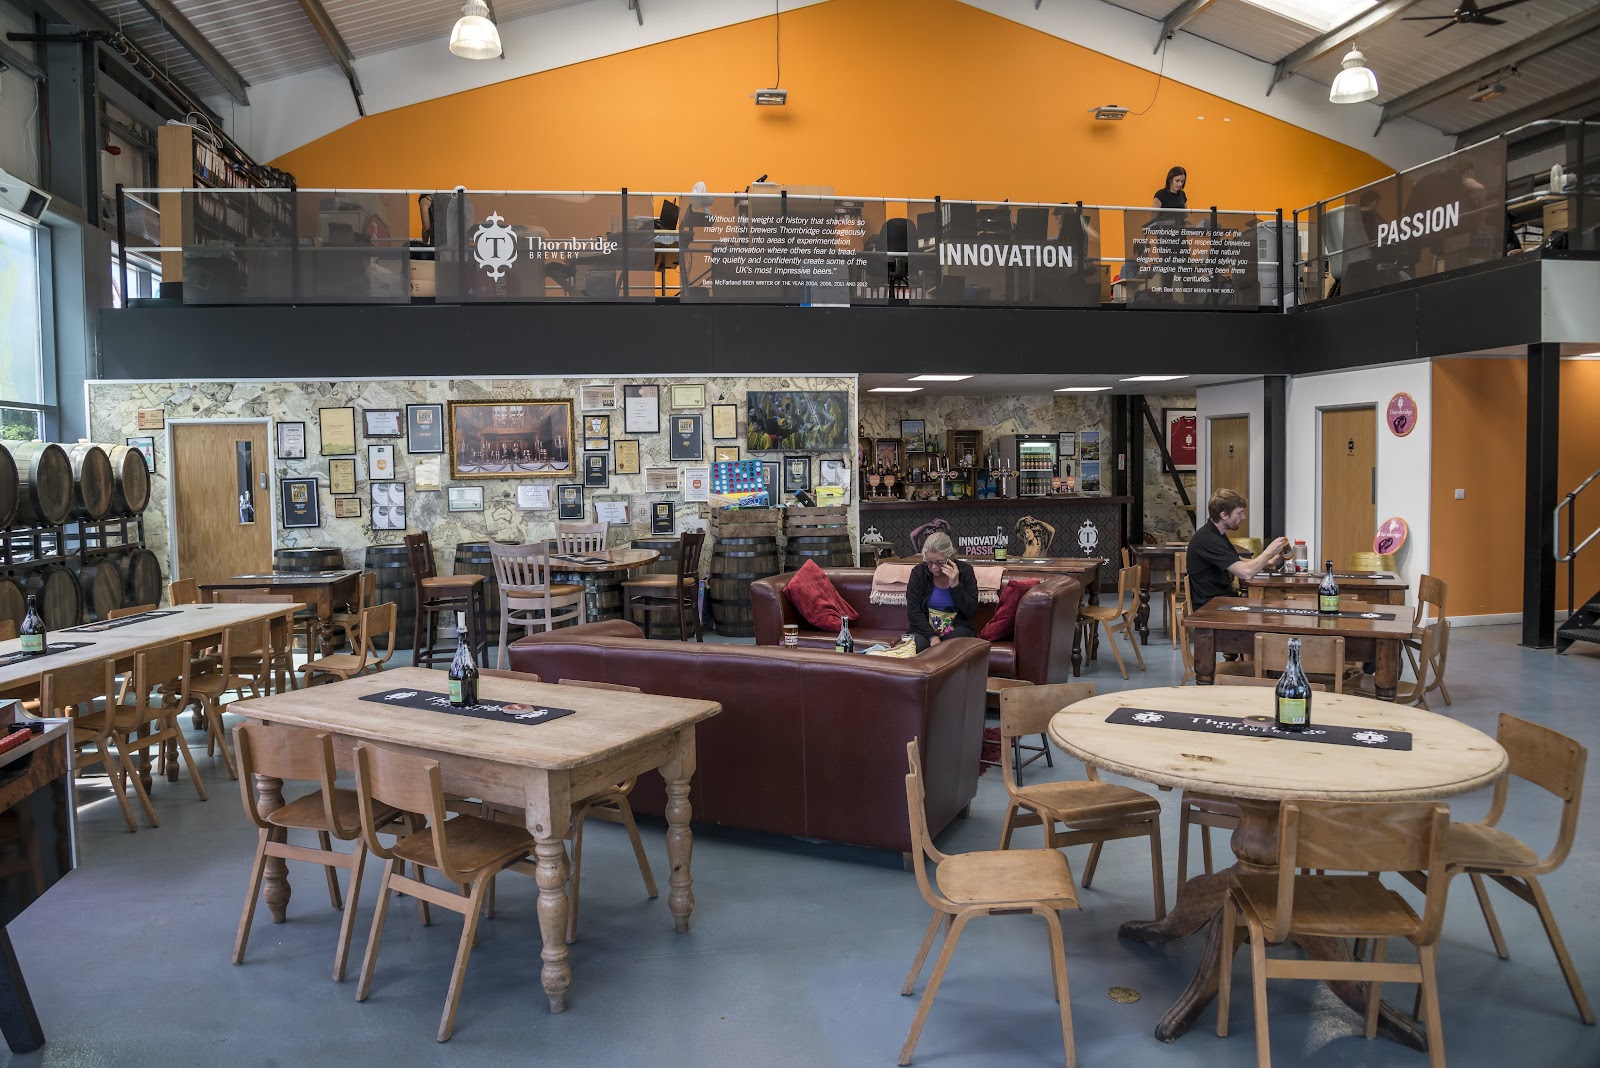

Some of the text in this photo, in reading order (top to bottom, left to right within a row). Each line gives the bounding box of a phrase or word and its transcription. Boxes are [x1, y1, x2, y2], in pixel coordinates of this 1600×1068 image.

[737, 215, 749, 223] the
[751, 216, 774, 225] weight
[776, 216, 784, 224] of
[785, 217, 809, 226] history
[810, 217, 825, 225] that
[826, 218, 855, 226] shackles
[1377, 201, 1460, 248] PASSION
[703, 225, 867, 237] many British brewers Thornbridge courageously
[1181, 229, 1205, 237] Brewery
[526, 236, 618, 255] Thornbridge
[720, 236, 749, 244] ventures
[751, 236, 765, 244] into
[797, 237, 851, 246] experimentation
[1194, 239, 1222, 247] respected
[730, 246, 765, 254] innovation
[1192, 248, 1208, 256] given
[1221, 248, 1241, 256] natural
[529, 251, 580, 260] BREWERY
[939, 243, 1073, 268] INNOVATION
[704, 256, 721, 265] They
[722, 256, 746, 265] quietly
[748, 256, 762, 264] and
[763, 256, 802, 265] confidently
[856, 258, 868, 266] the
[1136, 256, 1163, 264] elegance
[1172, 256, 1186, 264] their
[1218, 258, 1236, 266] styling
[774, 267, 811, 275] impressive
[1194, 267, 1214, 275] having
